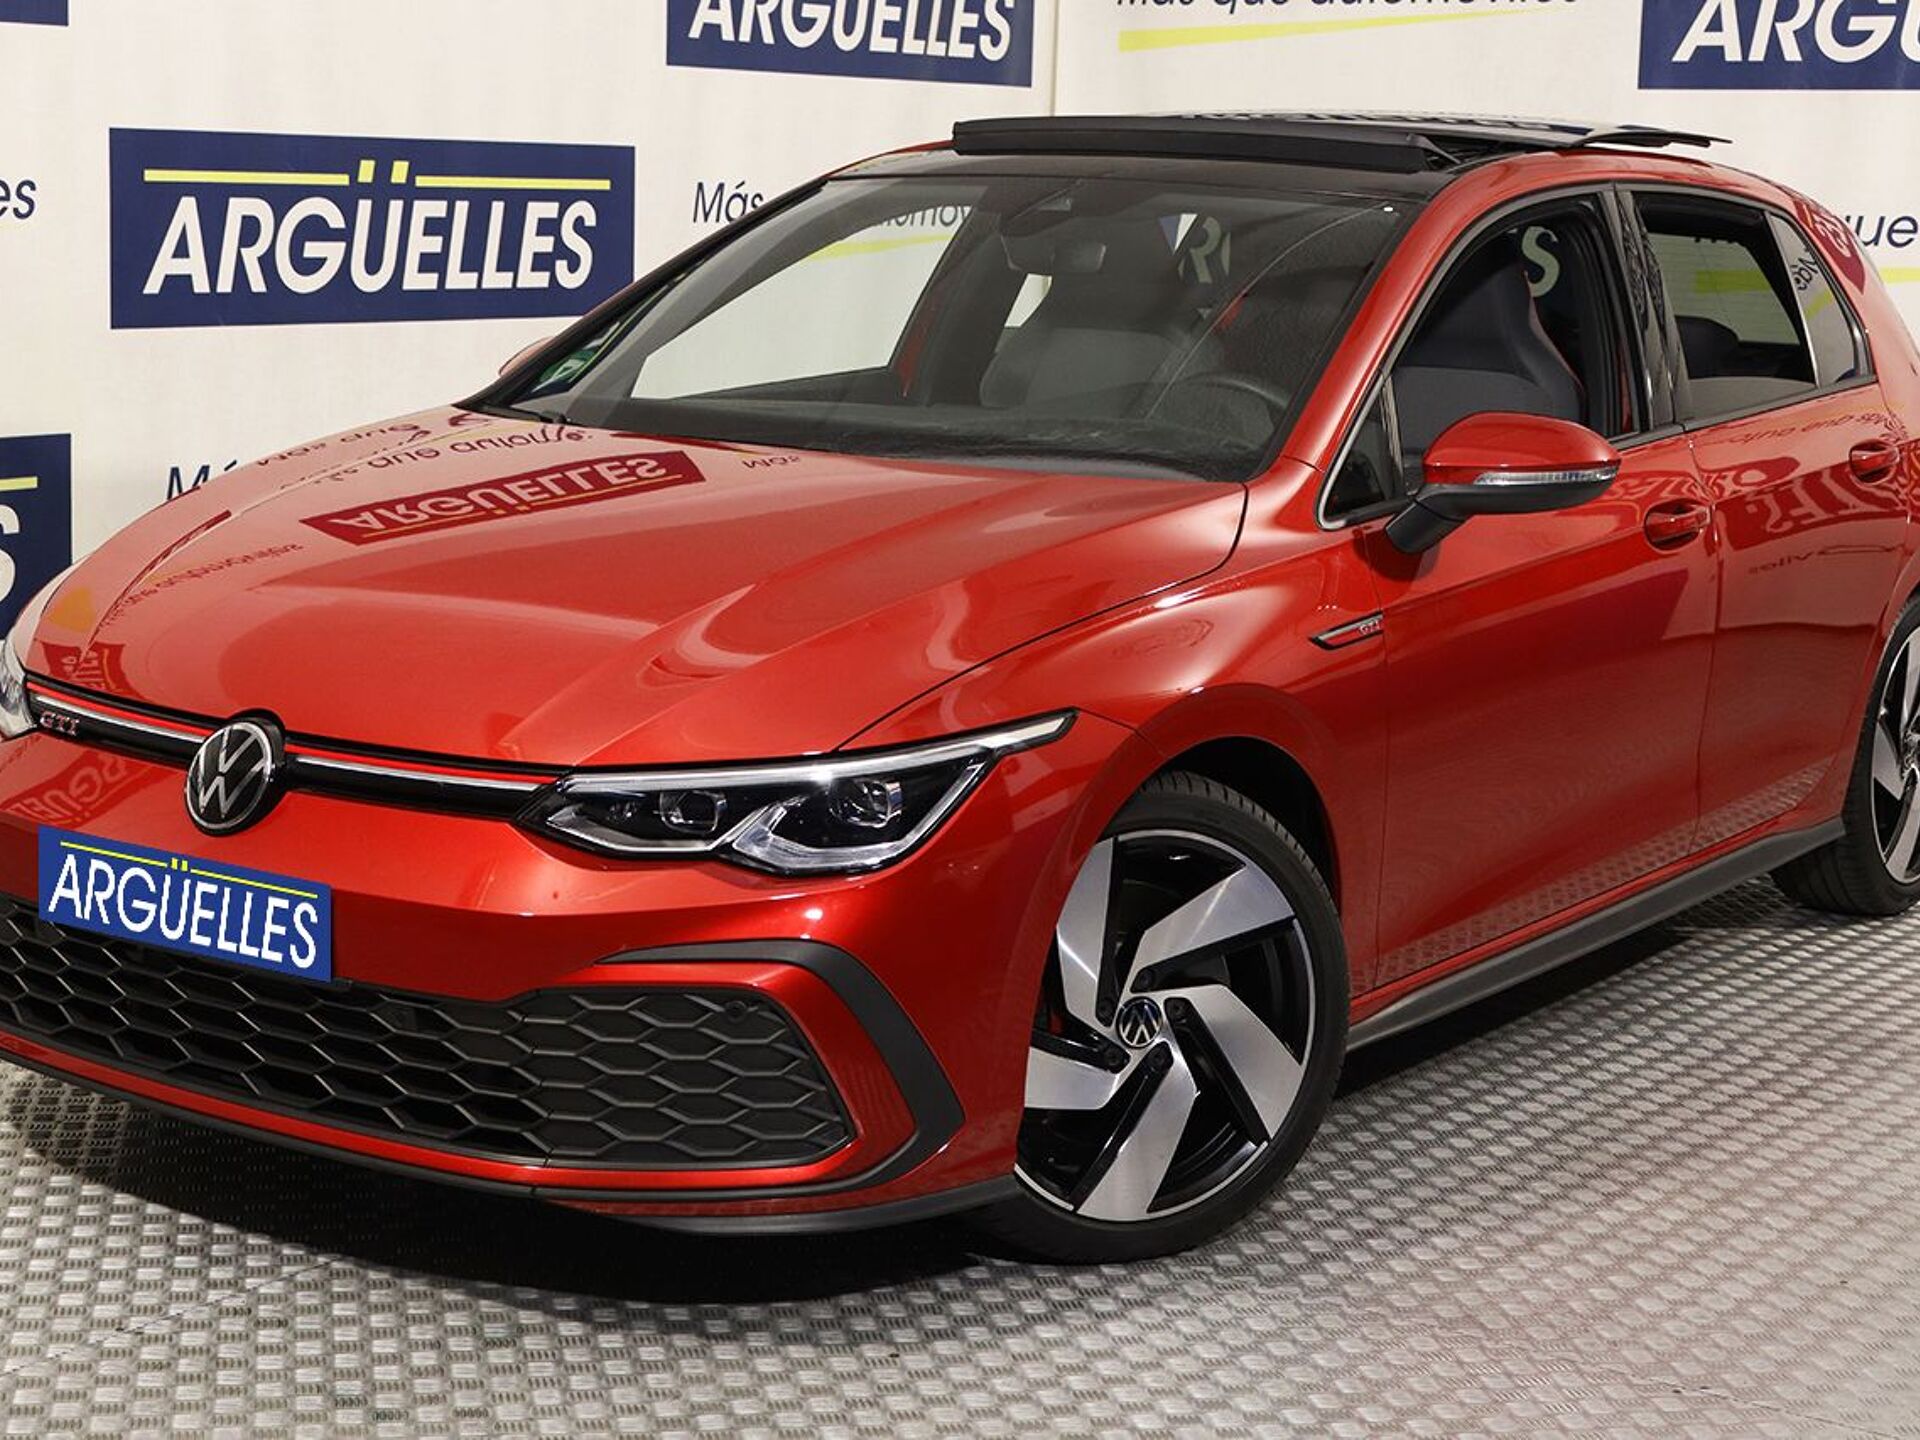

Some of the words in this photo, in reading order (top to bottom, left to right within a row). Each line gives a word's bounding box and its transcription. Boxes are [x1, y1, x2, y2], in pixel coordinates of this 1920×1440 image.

[143, 159, 597, 295] ARGÜELLES
[1845, 215, 1919, 248] ue
[40, 710, 80, 736] GTI
